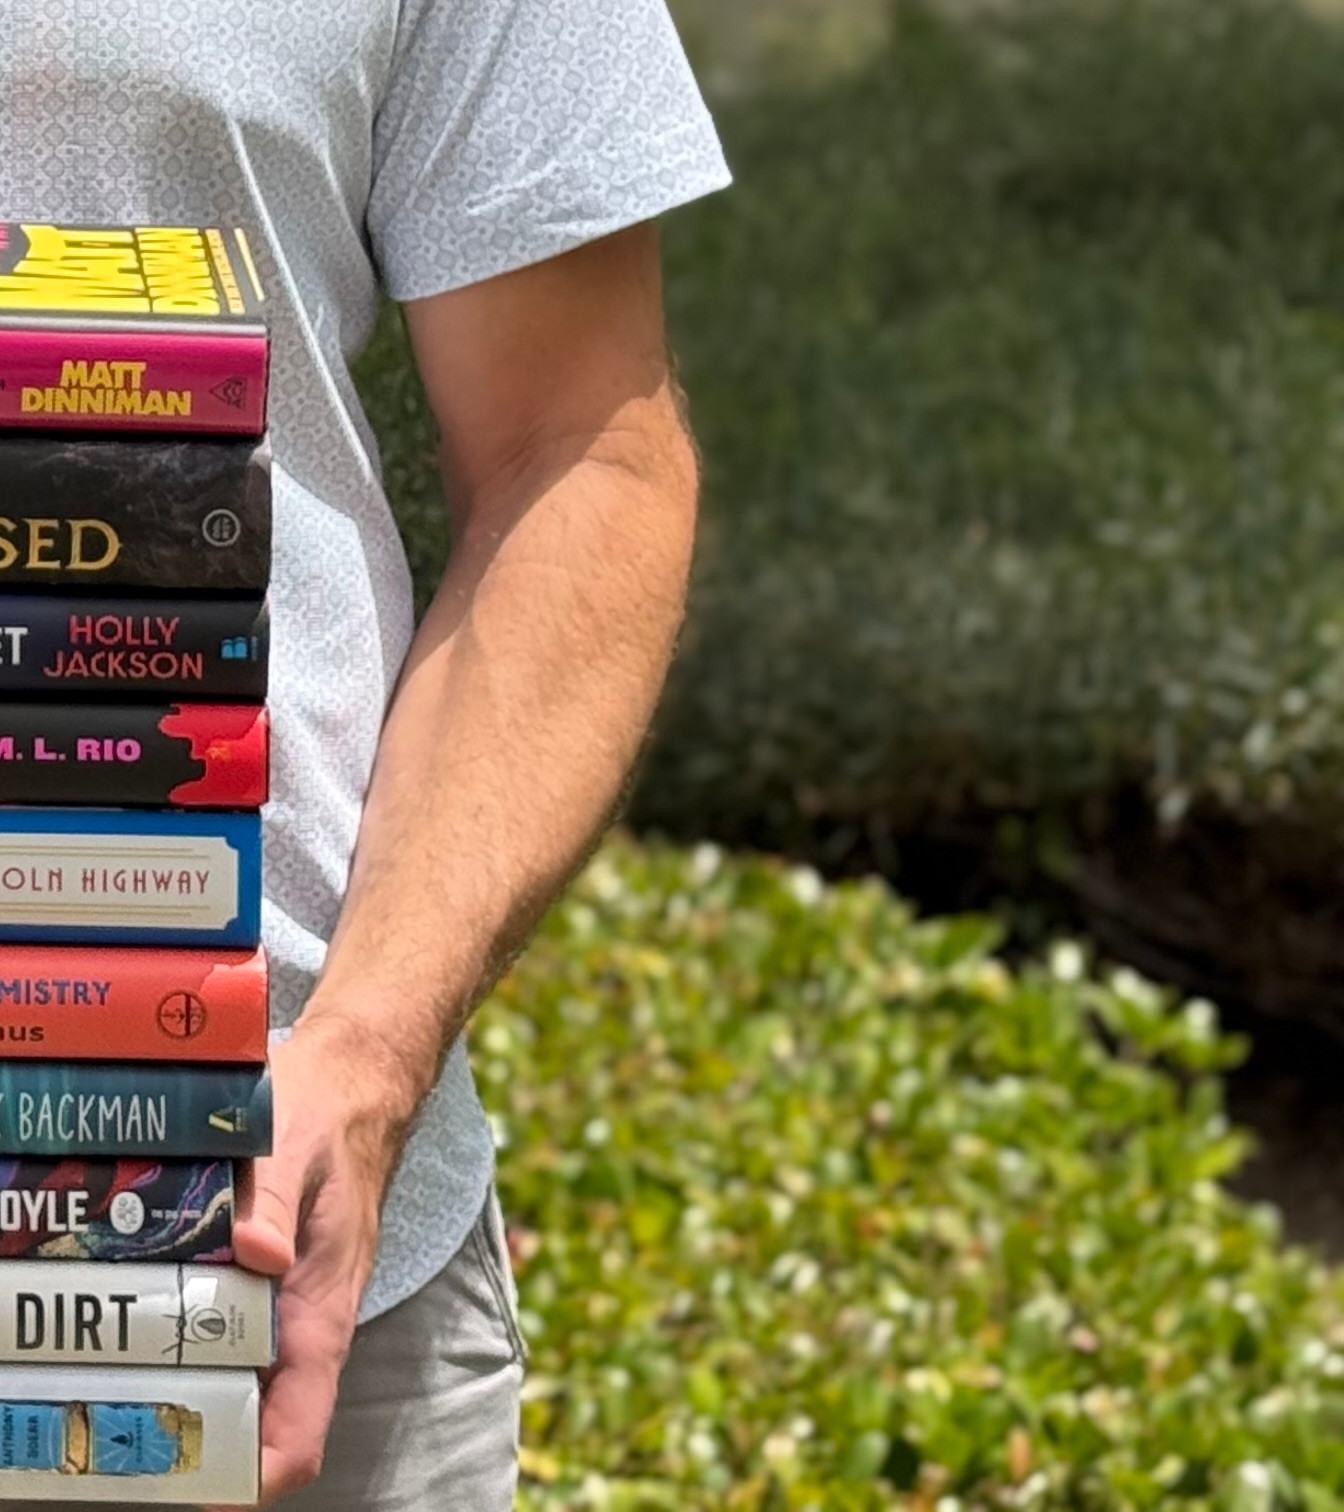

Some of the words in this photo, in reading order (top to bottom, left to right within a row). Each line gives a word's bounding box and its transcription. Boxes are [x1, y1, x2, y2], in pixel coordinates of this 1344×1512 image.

[61, 359, 147, 389] MATT
[21, 387, 192, 416] DINNIMAN
[69, 614, 180, 646] HOLLY
[43, 650, 204, 681] JACKSON
[34, 737, 66, 762] L.
[76, 738, 143, 762] RIO
[81, 868, 210, 895] HIGHWAY
[18, 1091, 167, 1143] BACKMAN
[16, 1291, 138, 1352] DIRT
